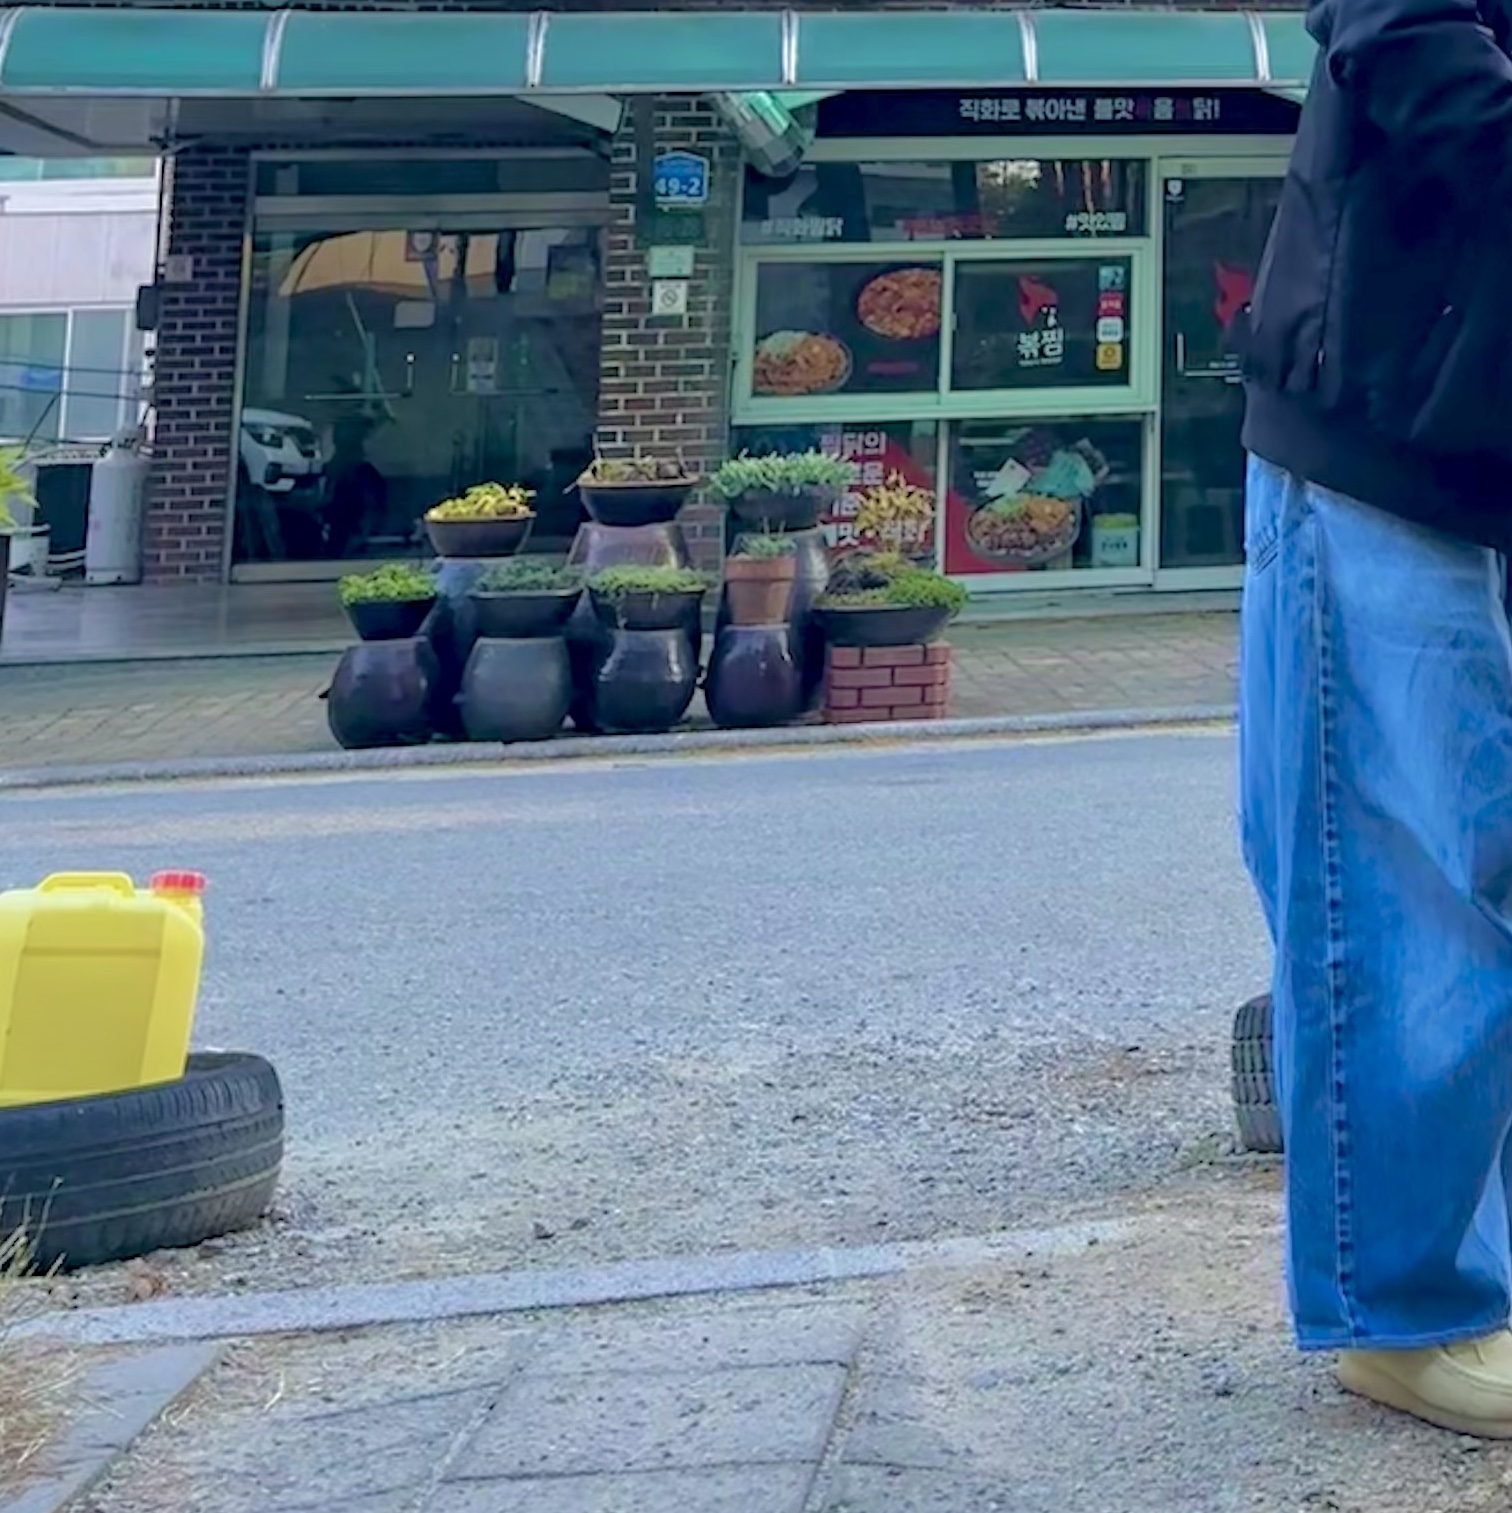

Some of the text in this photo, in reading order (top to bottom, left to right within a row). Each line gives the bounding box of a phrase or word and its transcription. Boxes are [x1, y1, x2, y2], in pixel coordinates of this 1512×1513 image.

[959, 98, 1021, 121] 직화로
[655, 177, 701, 195] 49-2
[1017, 328, 1063, 359] 볶찜
